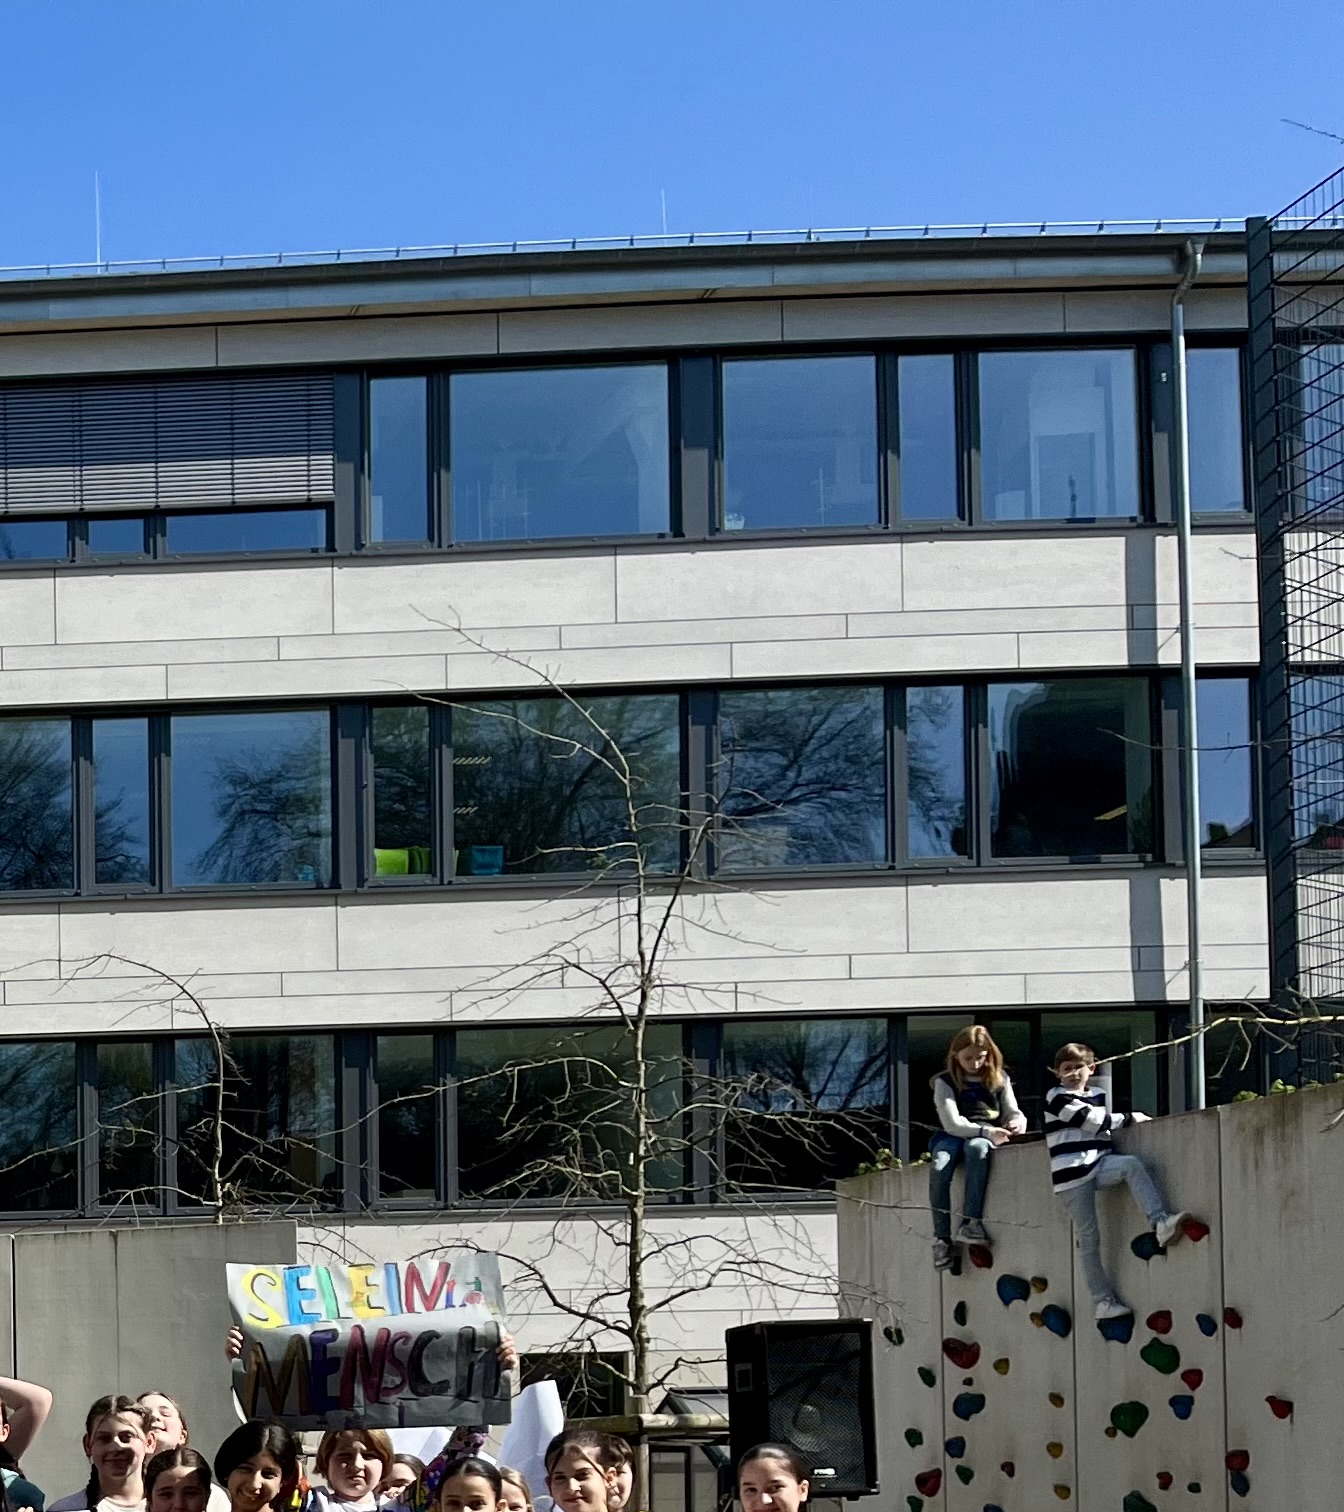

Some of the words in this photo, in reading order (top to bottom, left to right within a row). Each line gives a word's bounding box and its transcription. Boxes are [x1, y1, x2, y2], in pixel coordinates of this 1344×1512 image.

[241, 1264, 352, 1329] SEI
[346, 1260, 452, 1320] EIN
[243, 1320, 502, 1418] MENSCH
